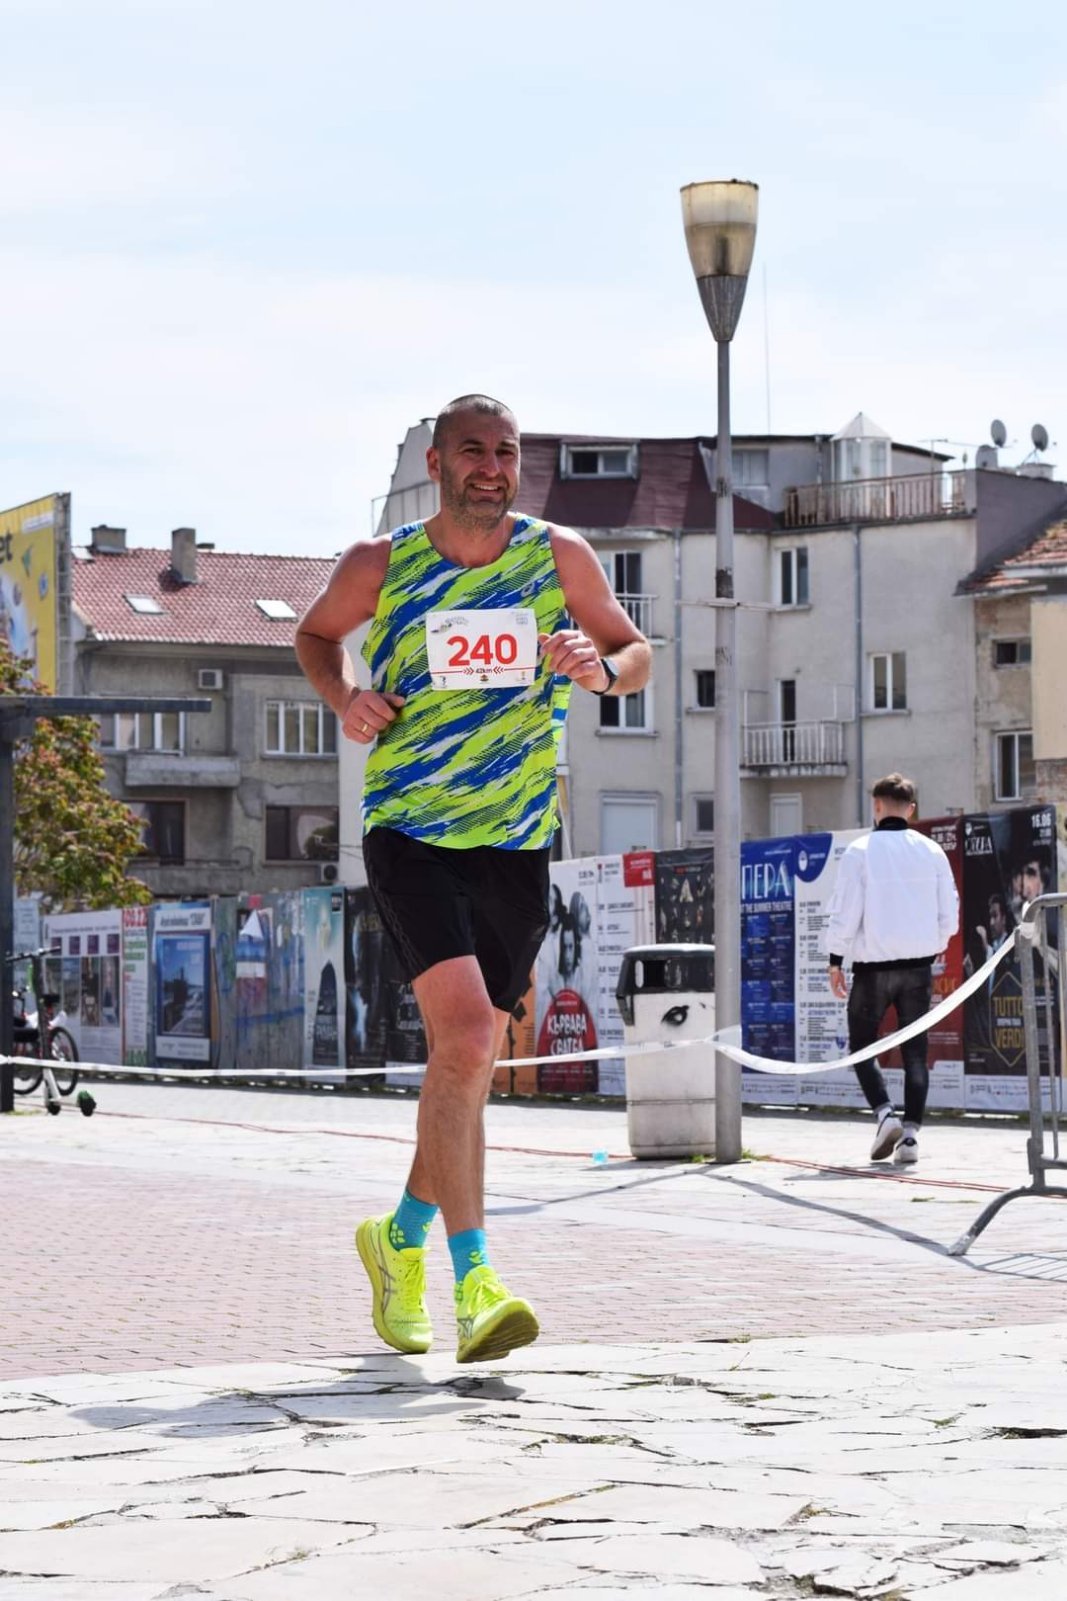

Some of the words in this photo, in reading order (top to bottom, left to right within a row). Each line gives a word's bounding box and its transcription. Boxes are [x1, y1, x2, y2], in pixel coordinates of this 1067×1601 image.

[447, 634, 517, 666] 240
[741, 860, 792, 900] ПЕРА
[993, 996, 1024, 1016] TUTTO
[547, 1013, 587, 1035] КЪРВАВА
[995, 1028, 1024, 1049] VERDI
